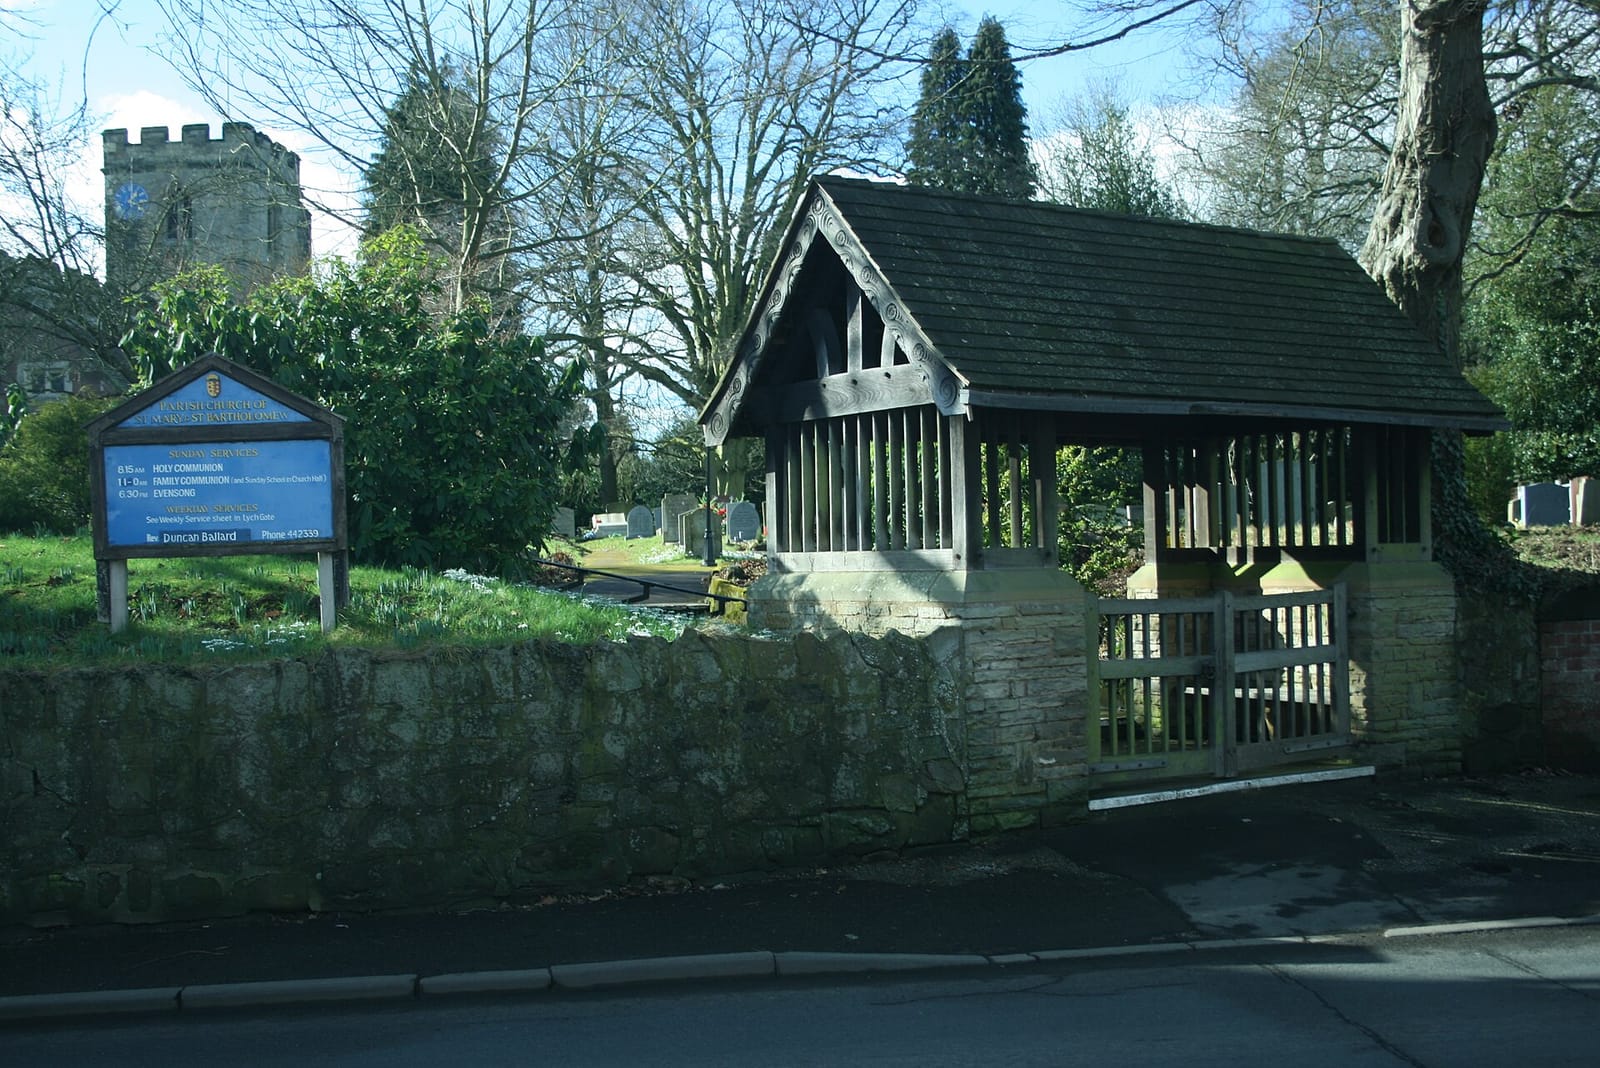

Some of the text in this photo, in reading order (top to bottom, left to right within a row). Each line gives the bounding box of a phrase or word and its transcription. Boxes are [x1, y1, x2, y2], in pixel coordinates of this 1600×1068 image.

[160, 399, 267, 411] PARISH CHURCH OF
[152, 413, 182, 424] MARY
[192, 413, 204, 422] ST
[207, 411, 288, 421] BARTHOLOMEW
[169, 448, 258, 458] SUNDAY SERVICES
[152, 464, 173, 473] HOLY
[174, 463, 224, 473] COMMUNION
[153, 477, 179, 486] FAMILY
[180, 475, 230, 485] COMMUNION
[153, 488, 196, 498] EVENSONG
[213, 504, 258, 513] SERVICES
[159, 515, 183, 524] Weekly
[185, 514, 211, 523] Service
[213, 514, 232, 522] sheet
[163, 533, 200, 543] Duncan
[201, 530, 237, 542] Ballard
[262, 530, 286, 540] Phone
